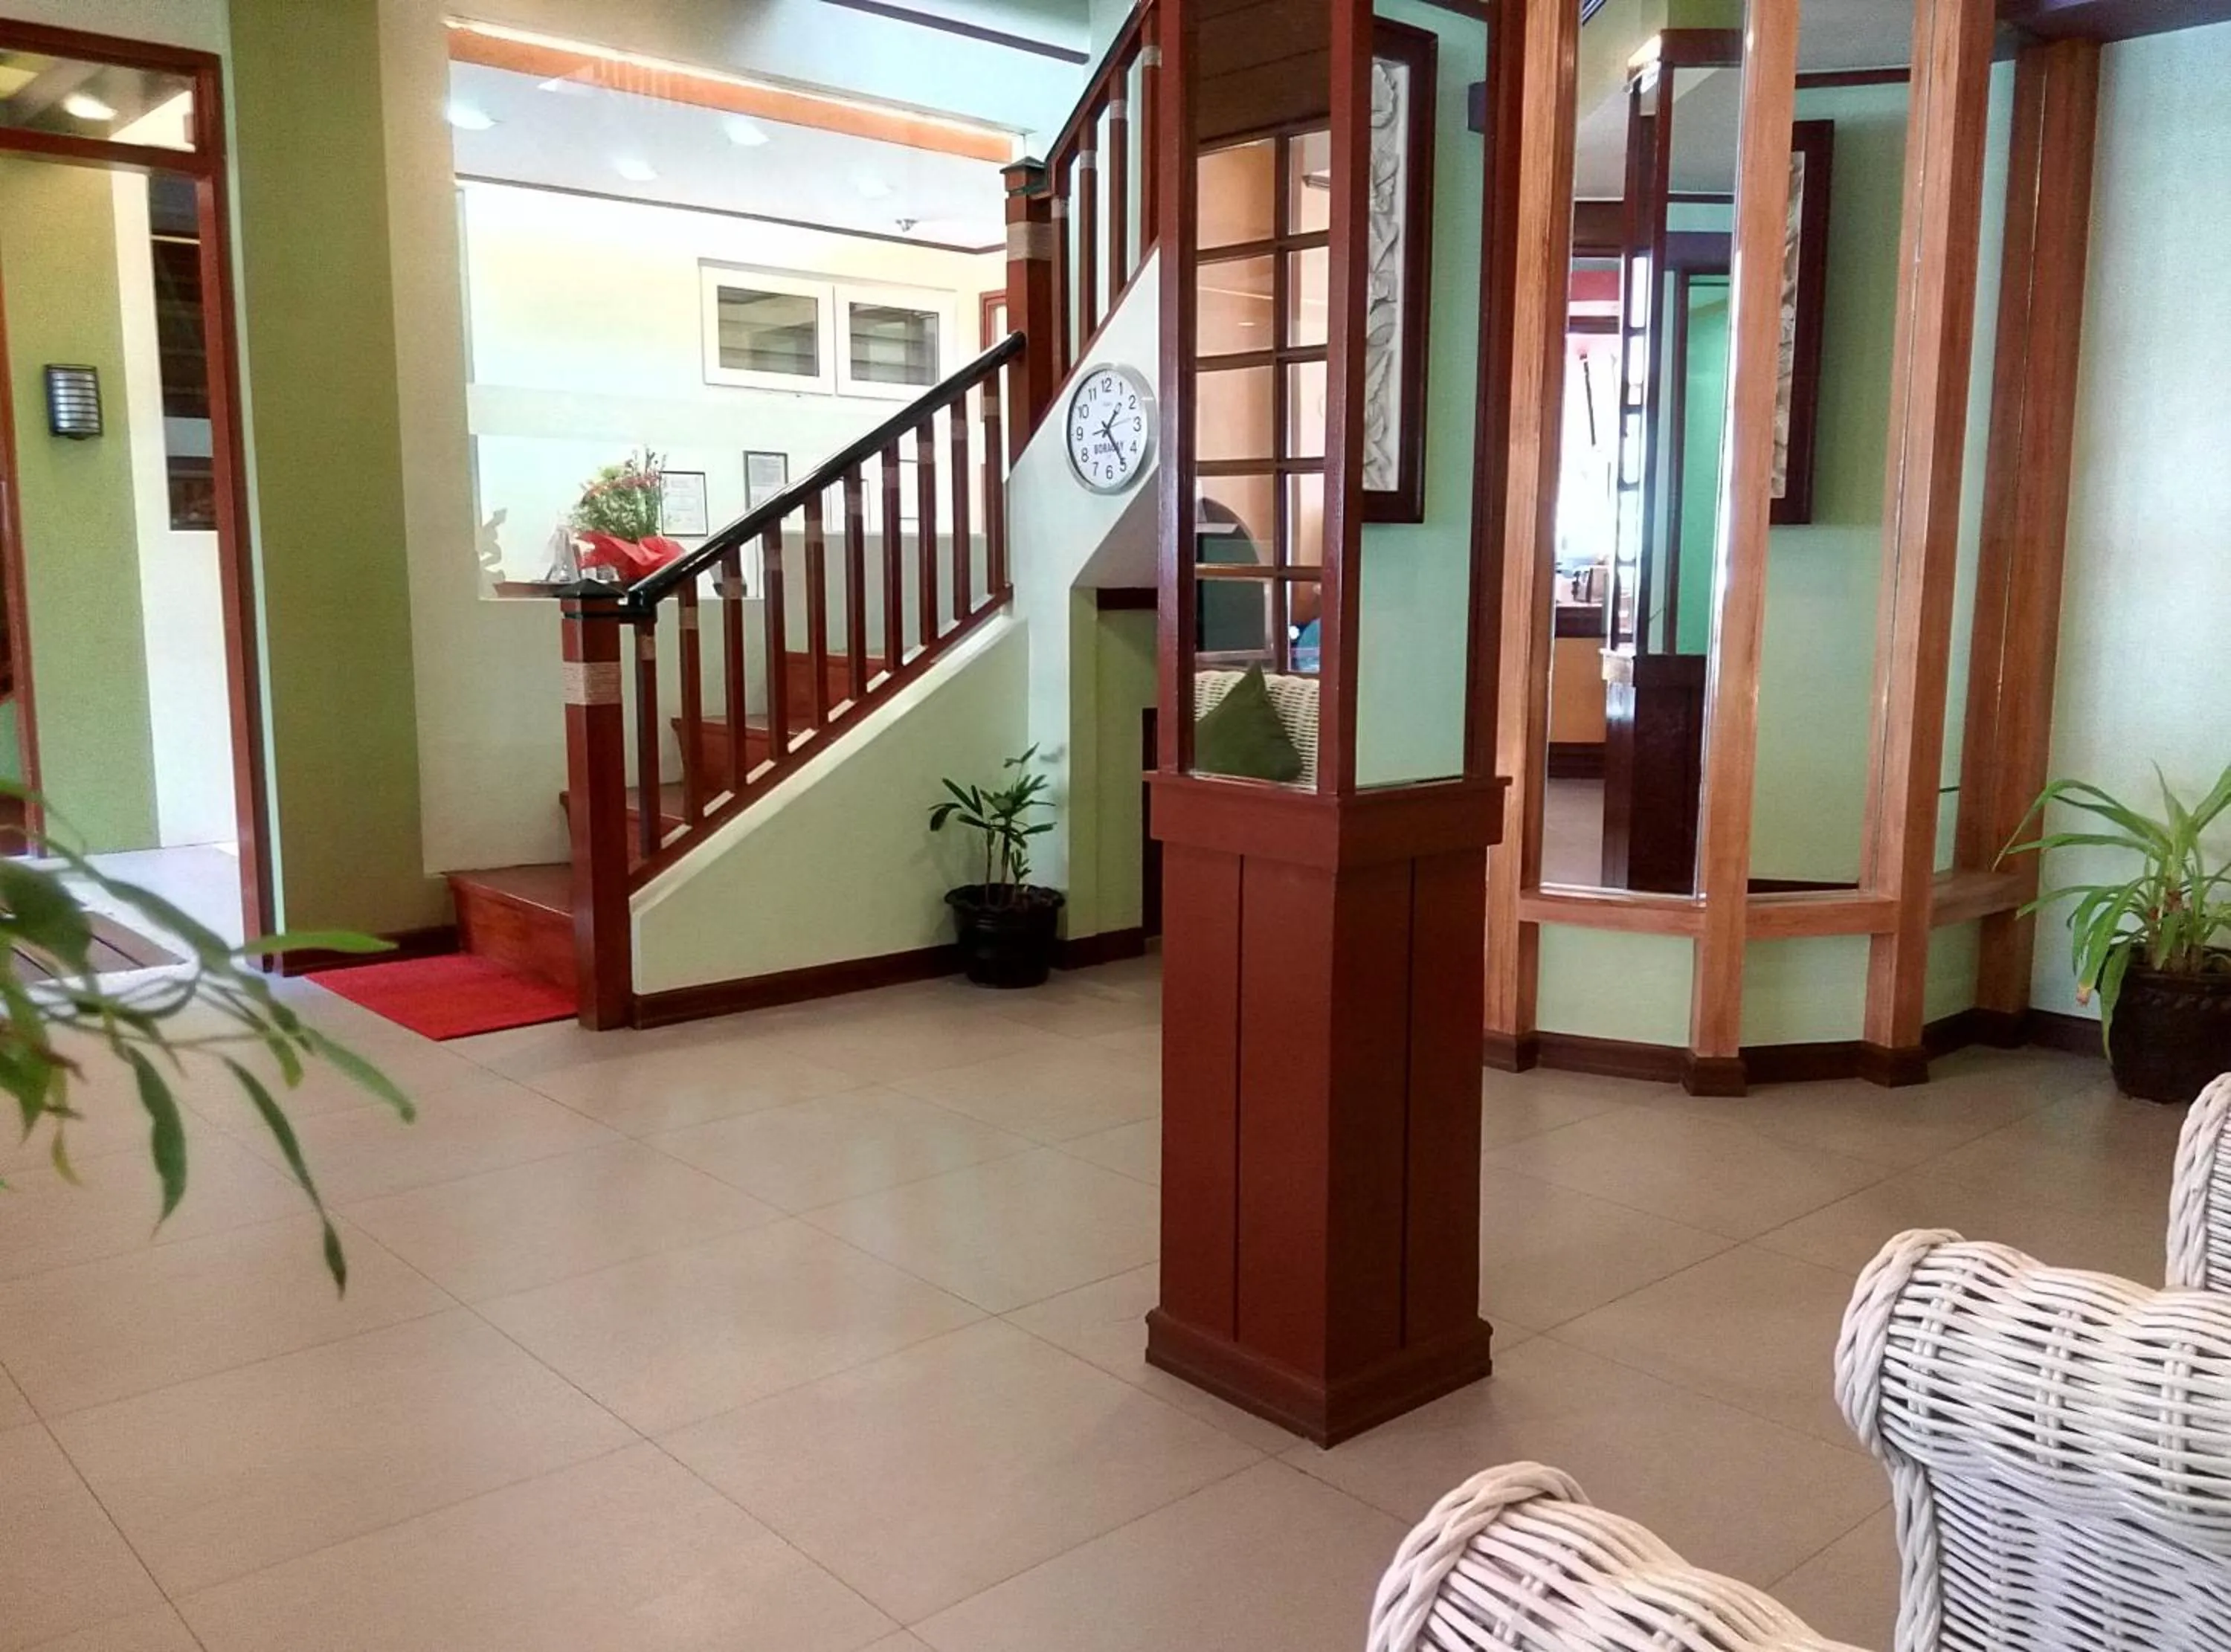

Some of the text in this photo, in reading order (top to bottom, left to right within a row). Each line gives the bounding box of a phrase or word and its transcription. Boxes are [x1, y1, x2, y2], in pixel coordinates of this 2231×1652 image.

[1101, 378, 1112, 393] 12
[1118, 381, 1123, 396] 1
[1088, 388, 1097, 401] 11
[1129, 395, 1136, 410] 2
[1078, 404, 1089, 419] 10
[1133, 416, 1142, 432] 3
[1076, 427, 1084, 441] 9
[1130, 440, 1137, 454] 4
[1081, 448, 1089, 462] 8
[1092, 462, 1099, 476] 7
[1106, 465, 1113, 480] 6
[1119, 459, 1127, 472] 5
